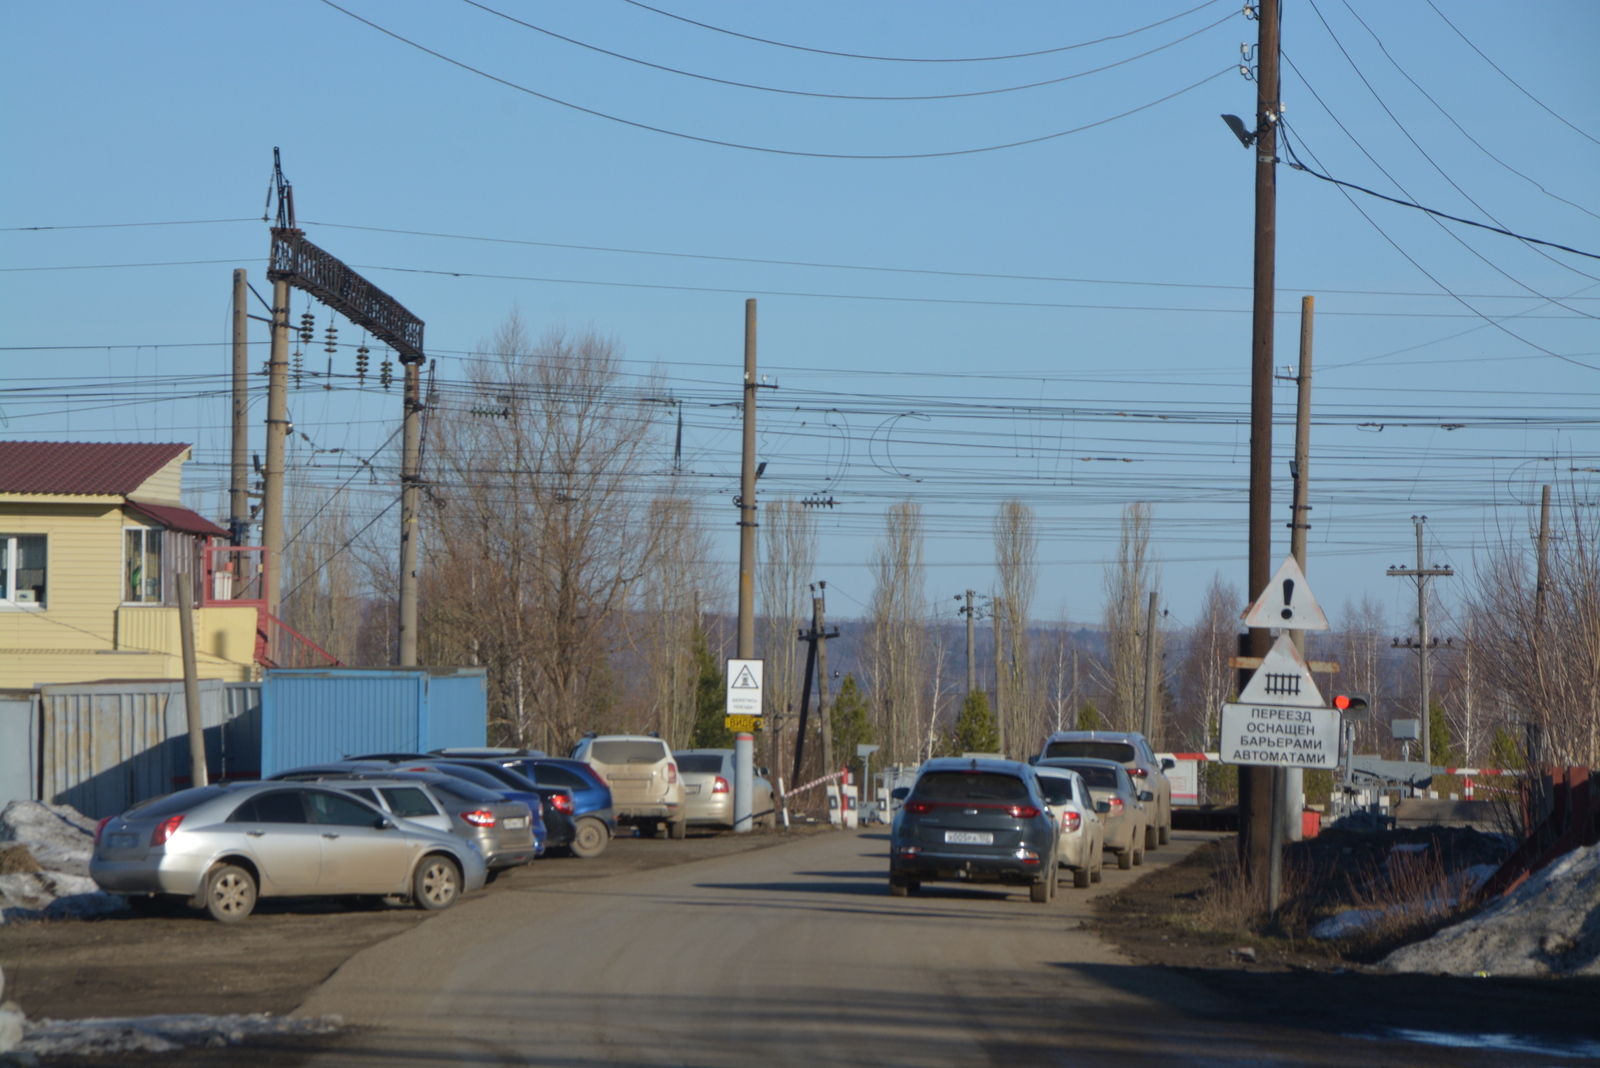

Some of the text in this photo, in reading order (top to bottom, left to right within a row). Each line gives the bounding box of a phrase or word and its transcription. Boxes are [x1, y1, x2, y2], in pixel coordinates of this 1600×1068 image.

[730, 718, 755, 727] ВИДЕ
[1251, 708, 1312, 723] ПЕРЕЕЗД
[1246, 722, 1315, 736] ОСНАЩЕН
[1240, 735, 1322, 750] БАРЬЕРАМИ
[1233, 750, 1326, 764] АВТОМАТАМИ
